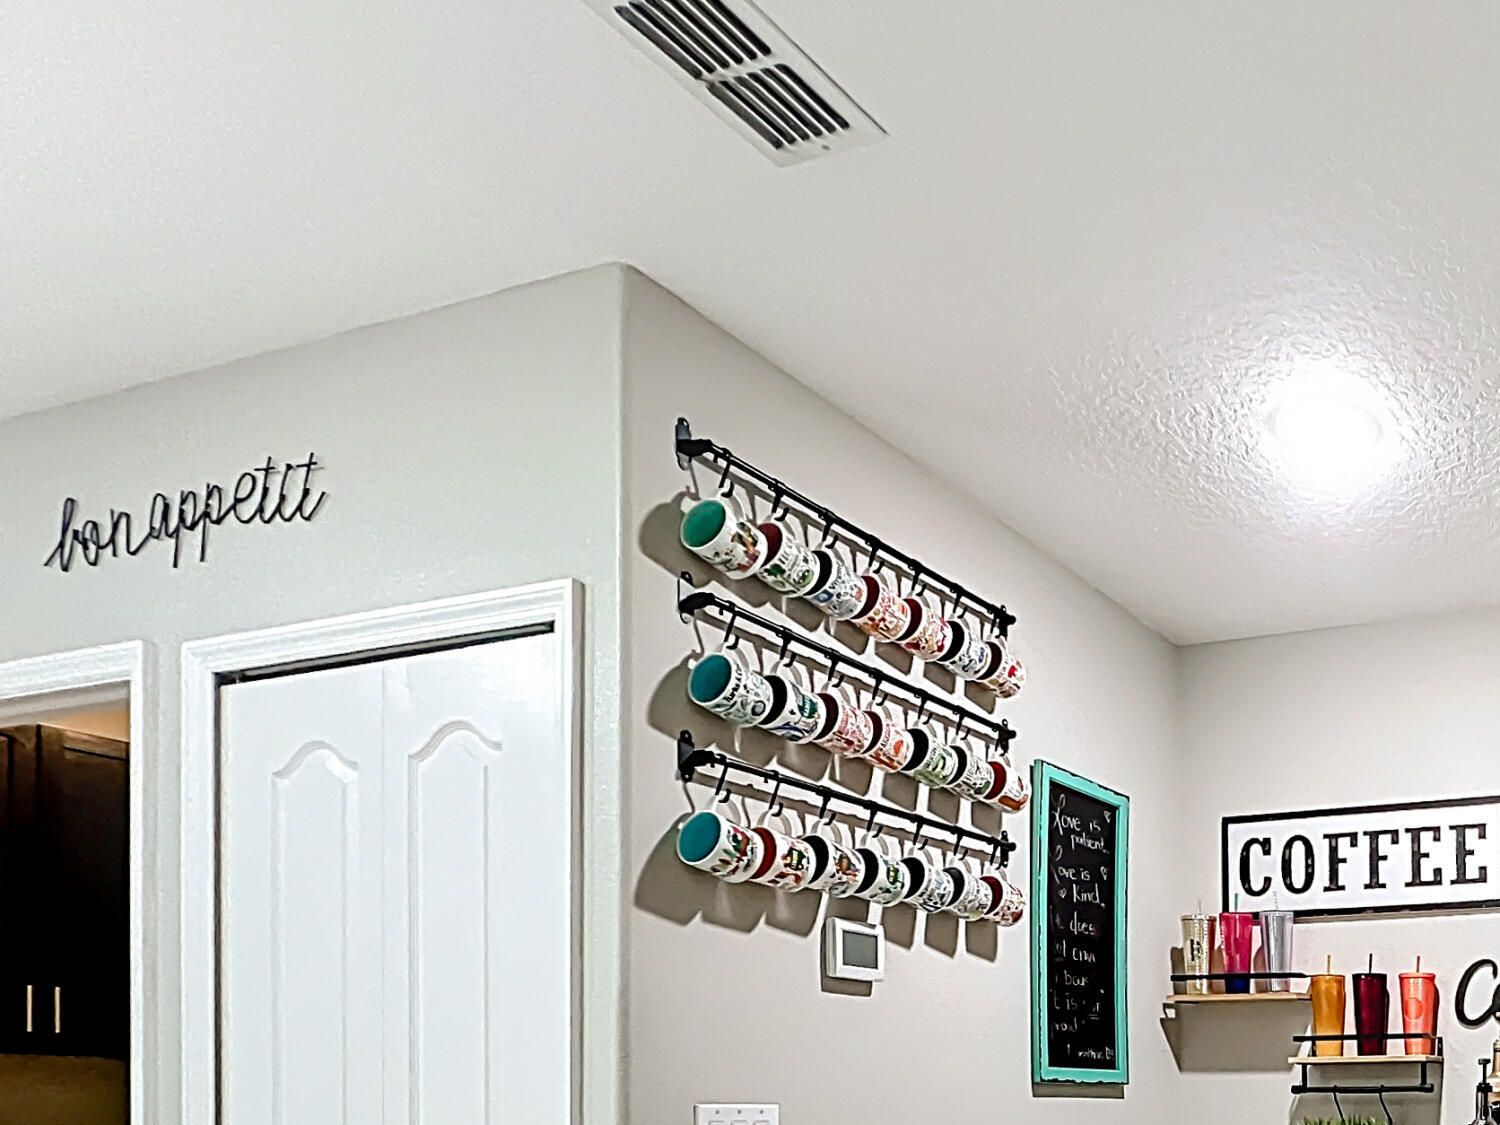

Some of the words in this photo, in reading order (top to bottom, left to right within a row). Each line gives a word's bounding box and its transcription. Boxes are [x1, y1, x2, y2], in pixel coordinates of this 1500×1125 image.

[1090, 820, 1101, 832] is
[1239, 823, 1488, 897] COFFEE
[1080, 868, 1091, 881] is
